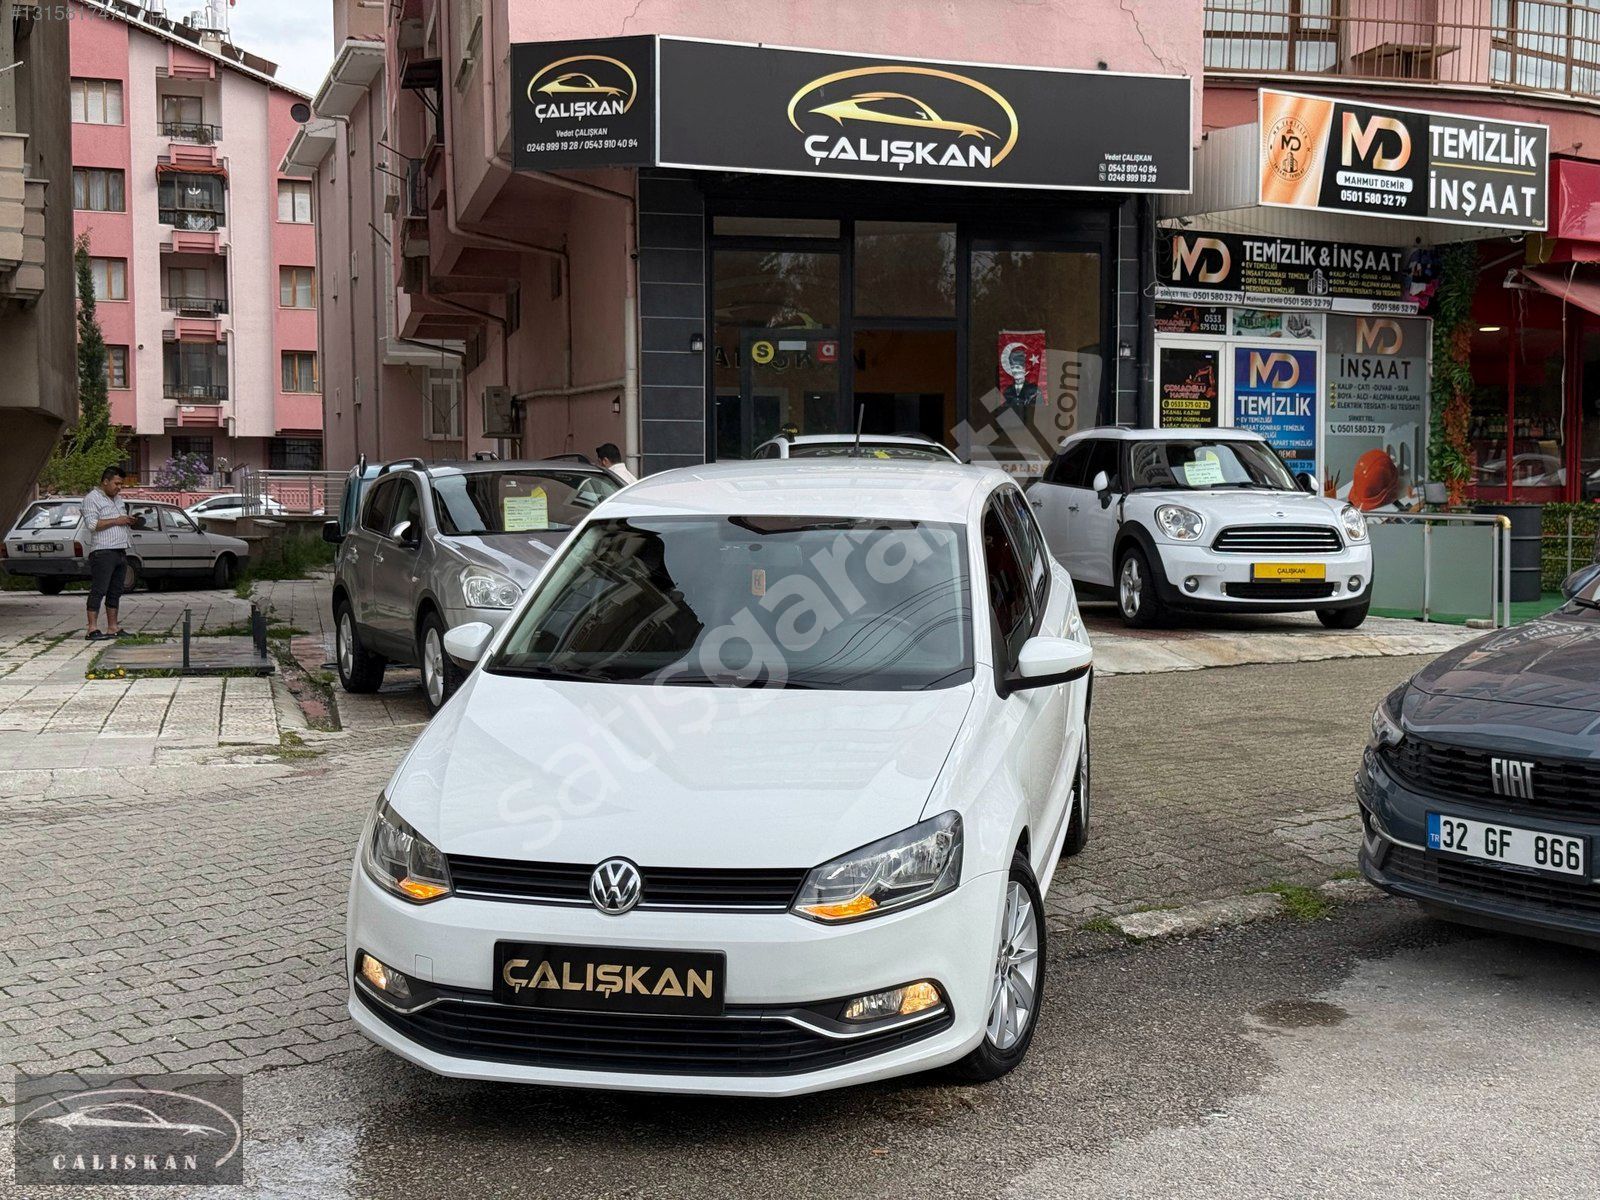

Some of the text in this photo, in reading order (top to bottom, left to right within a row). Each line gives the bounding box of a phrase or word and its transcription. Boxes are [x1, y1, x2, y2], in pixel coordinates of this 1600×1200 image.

[535, 100, 624, 123] ÇALIŞKAN
[556, 128, 608, 138] Vedat ÇALIŞKAN
[1341, 111, 1412, 172] MD
[526, 143, 545, 152] 0246
[546, 142, 560, 151] 999
[561, 142, 568, 150] 19
[569, 141, 578, 150] 28
[584, 140, 603, 149] 0543
[604, 140, 616, 148] 910
[617, 139, 627, 148] 40
[628, 138, 638, 147] 94
[1281, 134, 1301, 151] MD
[1428, 124, 1537, 167] TEMİZLİK
[804, 134, 992, 171] ÇALIŞKAN
[1122, 154, 1152, 162] ÇALIŞKAN
[1108, 164, 1157, 173] 0543 910 40 94
[1108, 173, 1126, 181] 0246
[1126, 174, 1139, 182] 999
[1140, 174, 1147, 182] 19
[1344, 176, 1405, 190] MAHMUT DEMİR
[1340, 189, 1407, 207] 0501 580 32 79
[1429, 171, 1537, 217] İNŞAAT
[1172, 235, 1231, 283] MD
[1242, 239, 1402, 272] TEMİZLİK & İNŞAAT
[1192, 291, 1243, 302] 0501 580 32 79
[1283, 297, 1299, 305] 0501
[1300, 298, 1312, 306] 585
[1323, 299, 1331, 307] 79
[1372, 303, 1417, 313] 0501 586 32 79
[1200, 323, 1209, 331] 575
[1210, 323, 1218, 331] 02
[1204, 314, 1221, 323] 0533
[1356, 318, 1403, 354] MD
[1249, 351, 1300, 389] MD
[1340, 353, 1411, 380] İNŞAAT
[1237, 392, 1311, 416] TEMİZLİK
[1337, 425, 1385, 433] 0501 580 32 79
[1276, 567, 1306, 575] ÇALIŞKAN
[1491, 757, 1535, 800] FIAT
[1430, 833, 1440, 843] TR
[1442, 819, 1580, 870] 32 GF 866
[503, 958, 713, 999] ÇALIŞKAN
